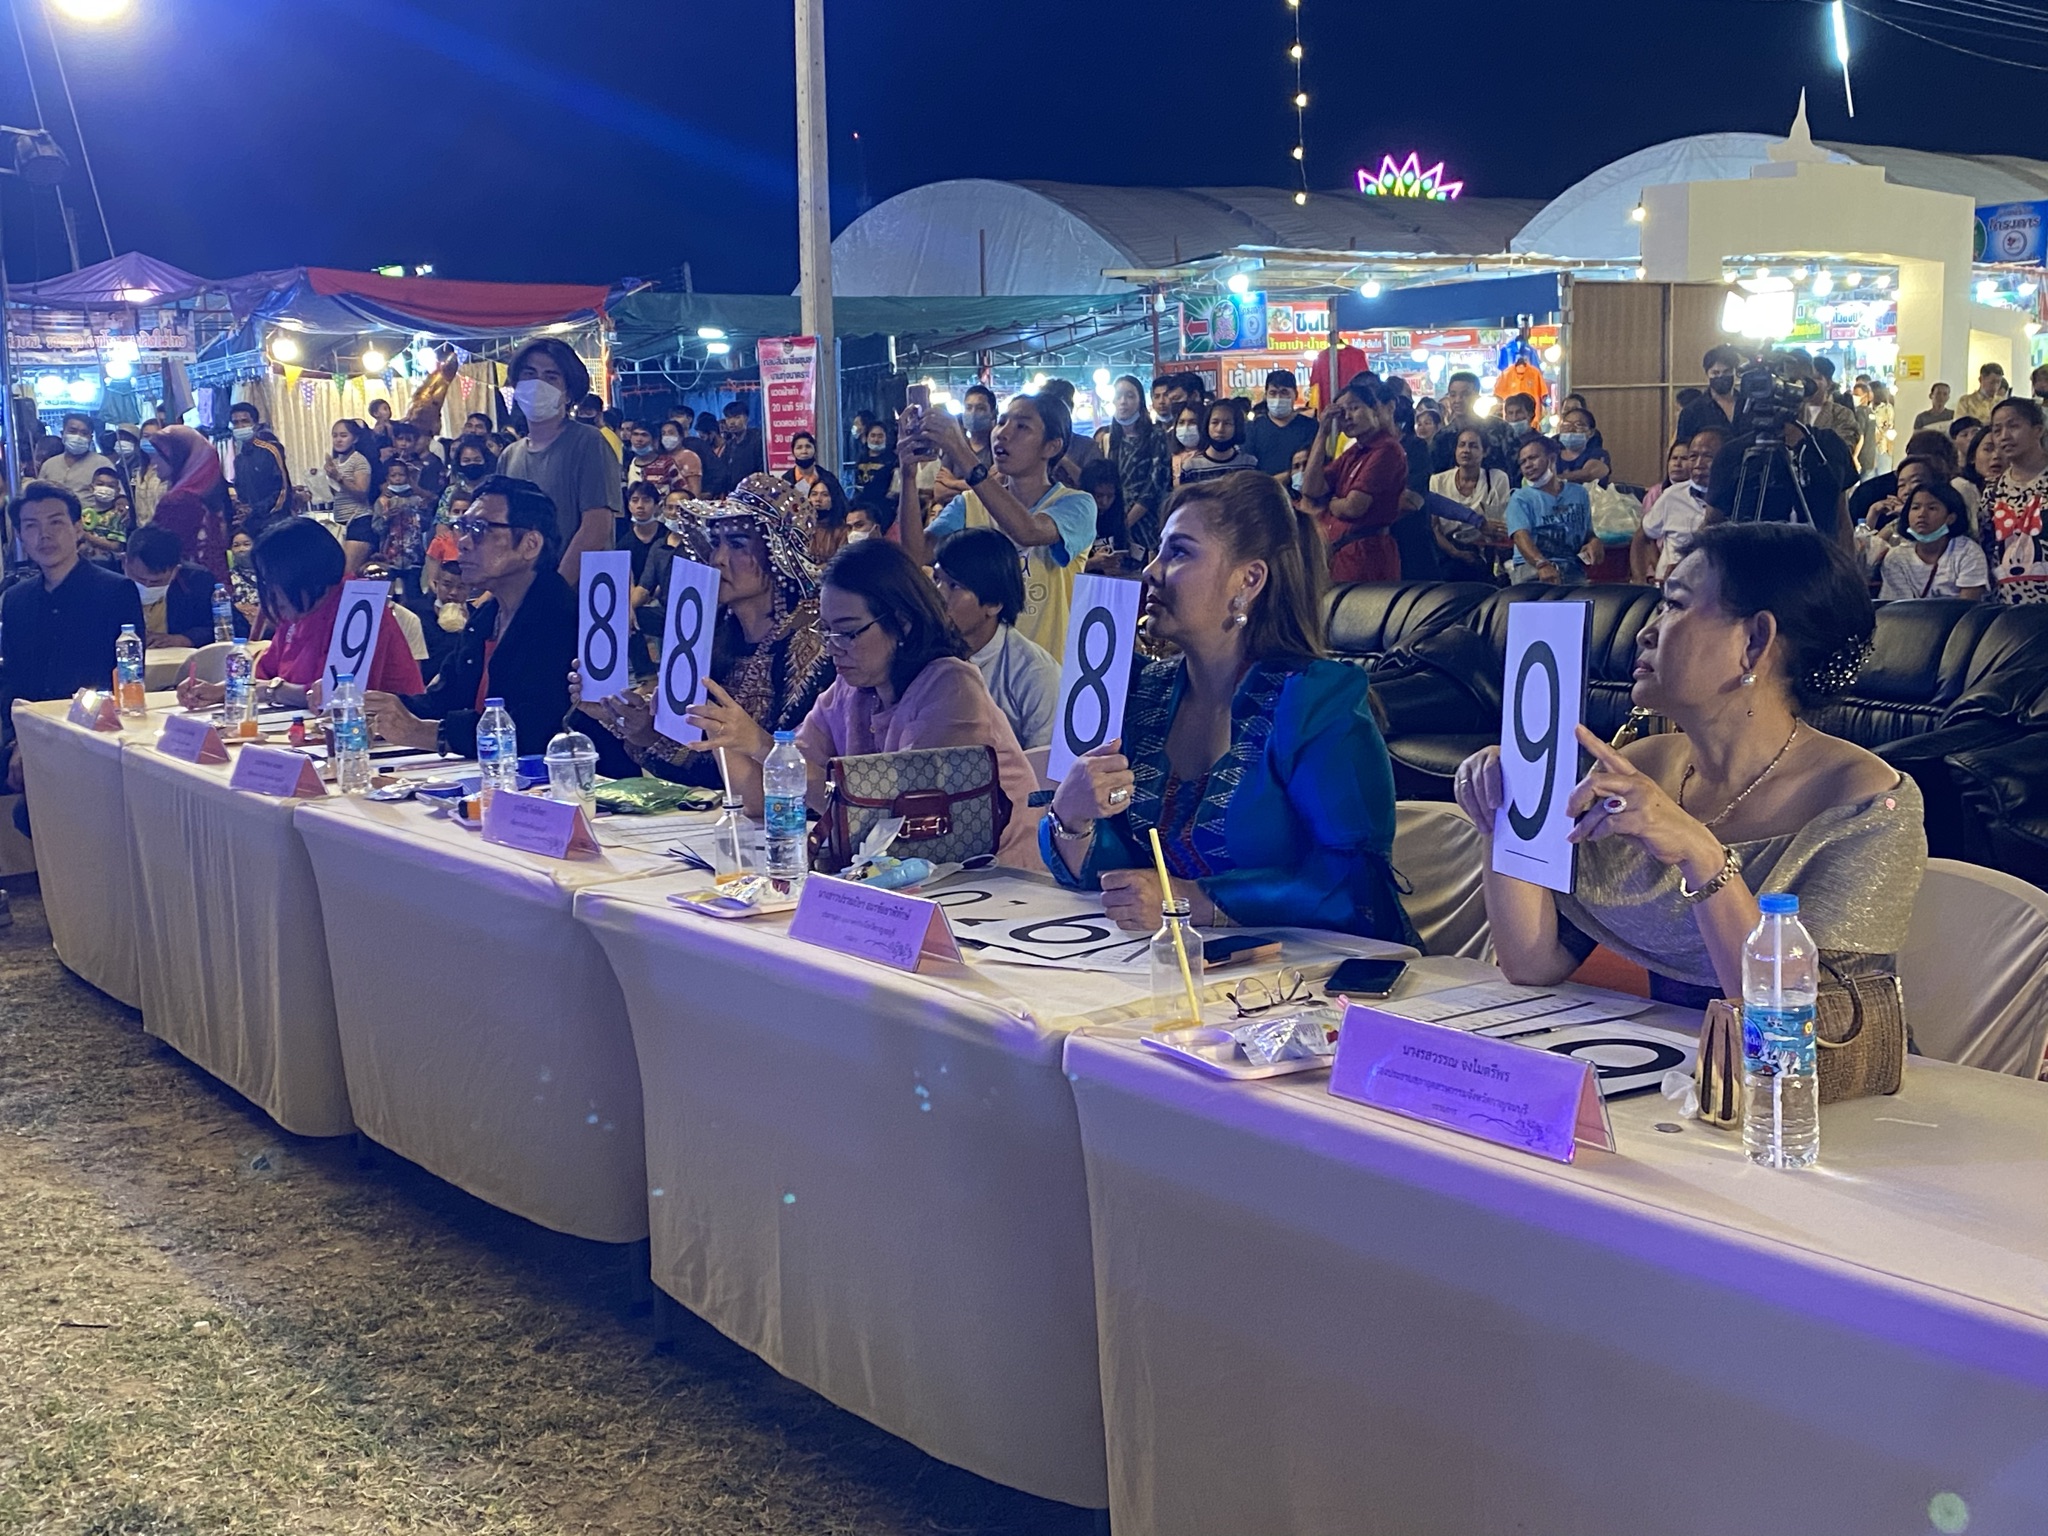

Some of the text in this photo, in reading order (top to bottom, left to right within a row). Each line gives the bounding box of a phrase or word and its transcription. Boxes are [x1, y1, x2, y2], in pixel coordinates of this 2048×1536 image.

[771, 403, 781, 412] 20
[774, 434, 784, 444] 30
[329, 598, 373, 692] 9
[583, 571, 618, 682] 8
[665, 586, 704, 718] 8
[1064, 606, 1117, 758] 8
[1508, 640, 1559, 842] 9
